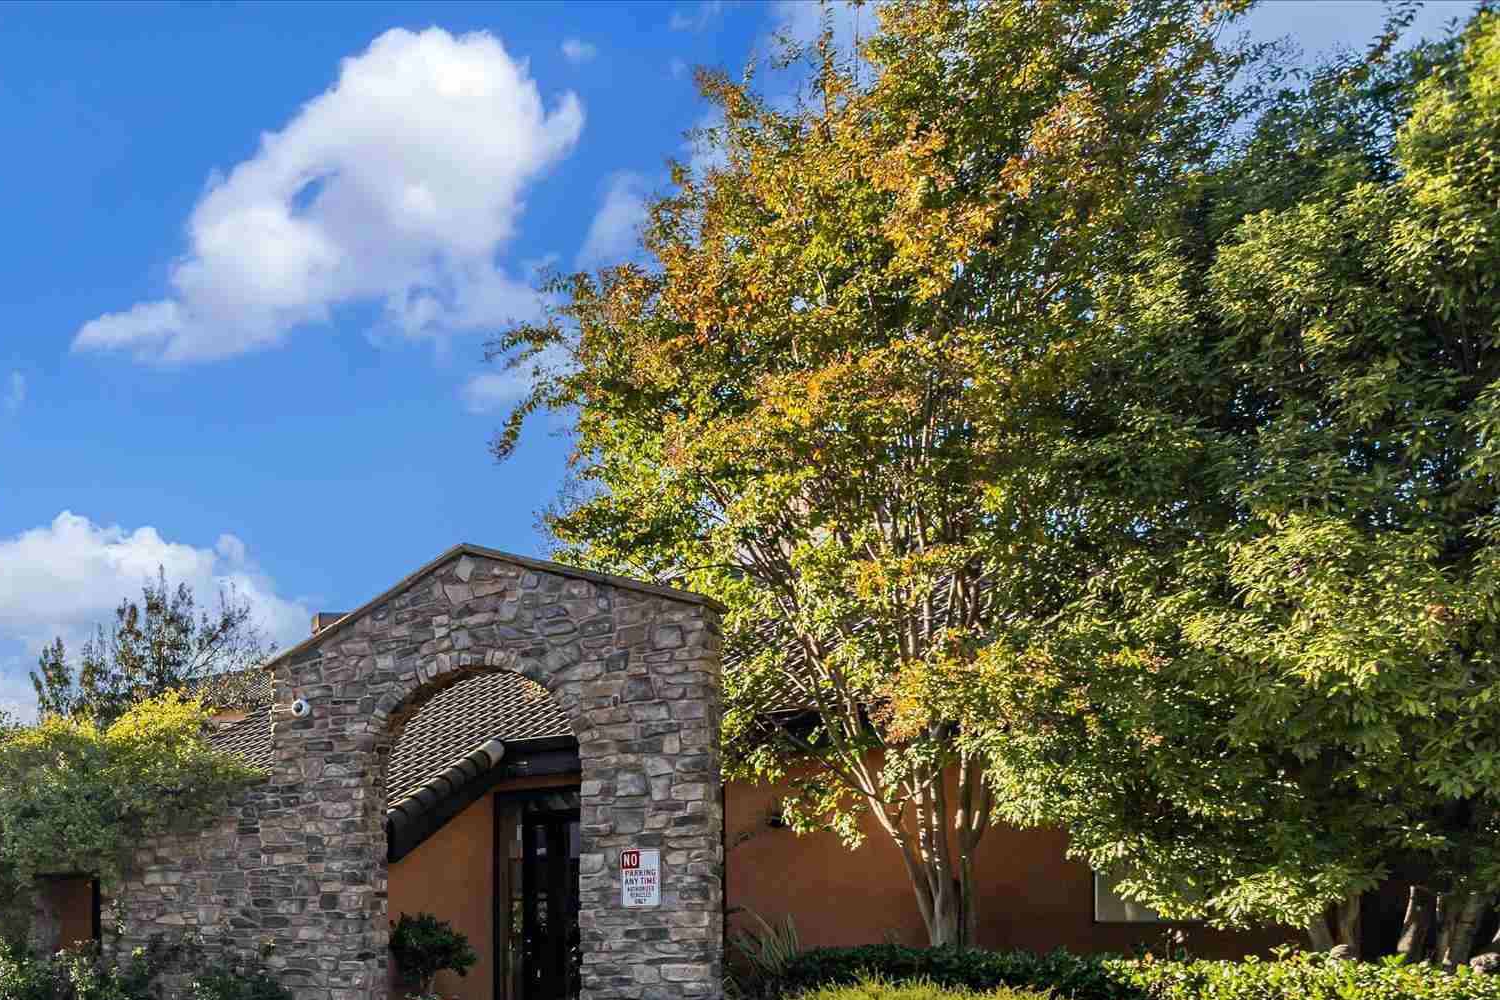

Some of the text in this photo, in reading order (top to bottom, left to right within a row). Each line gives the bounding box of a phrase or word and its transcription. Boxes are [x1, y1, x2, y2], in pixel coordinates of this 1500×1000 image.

[623, 853, 638, 866] NO
[625, 877, 656, 885] ANY TIME
